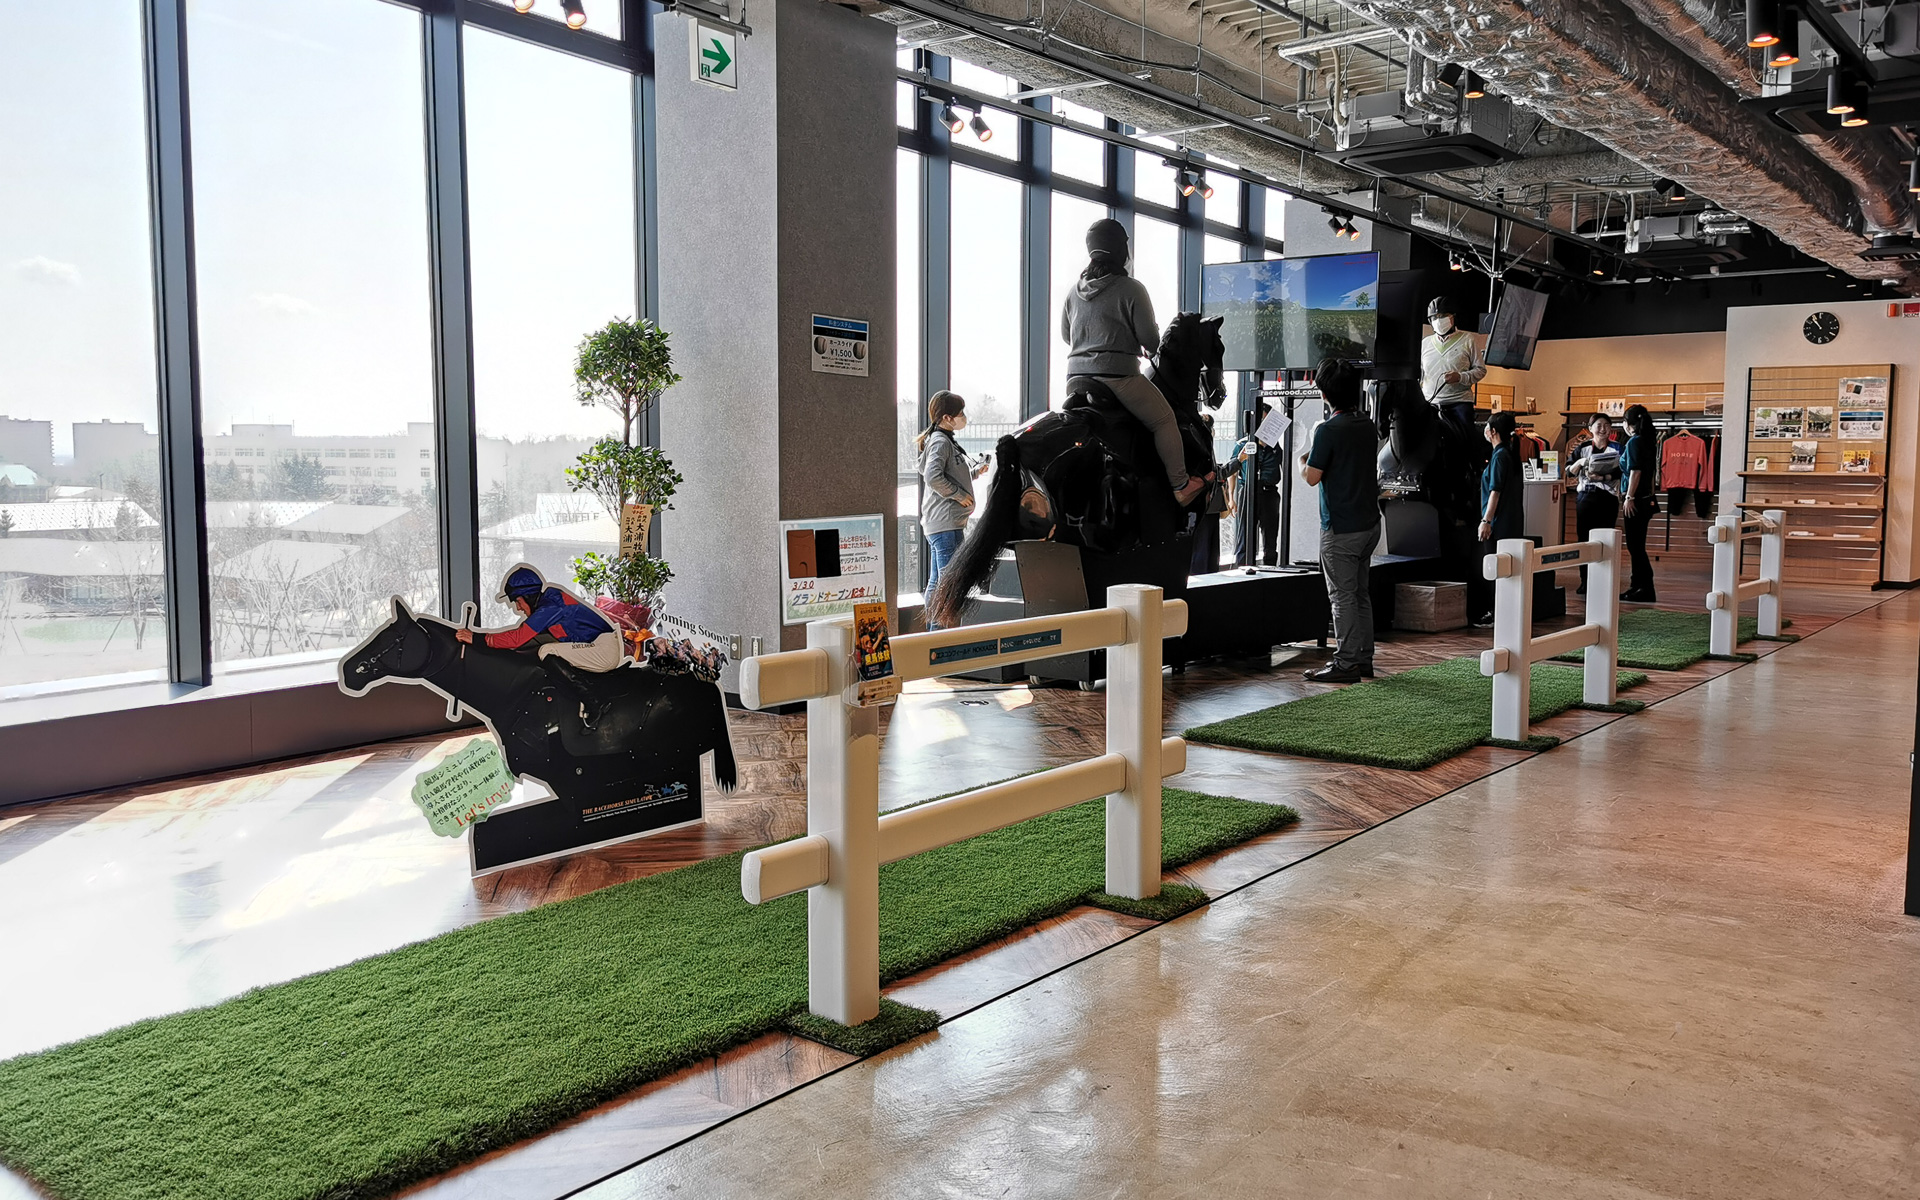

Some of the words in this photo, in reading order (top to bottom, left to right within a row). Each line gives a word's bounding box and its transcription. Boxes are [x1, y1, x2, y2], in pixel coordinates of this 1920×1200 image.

[829, 339, 852, 347] ホースライド
[830, 348, 852, 358] ¥1,500
[792, 580, 815, 591] 3/30
[652, 608, 697, 635] Coming
[698, 624, 730, 647] Soon!!
[420, 750, 497, 804] JRA競馬学校や育成牧場でも
[423, 746, 482, 787] 競馬シミュレーター
[432, 768, 501, 818] 本格的なジョッキー体験が
[455, 802, 486, 827] Let's
[485, 782, 511, 807] try!!
[593, 801, 624, 812] RACEHORSE
